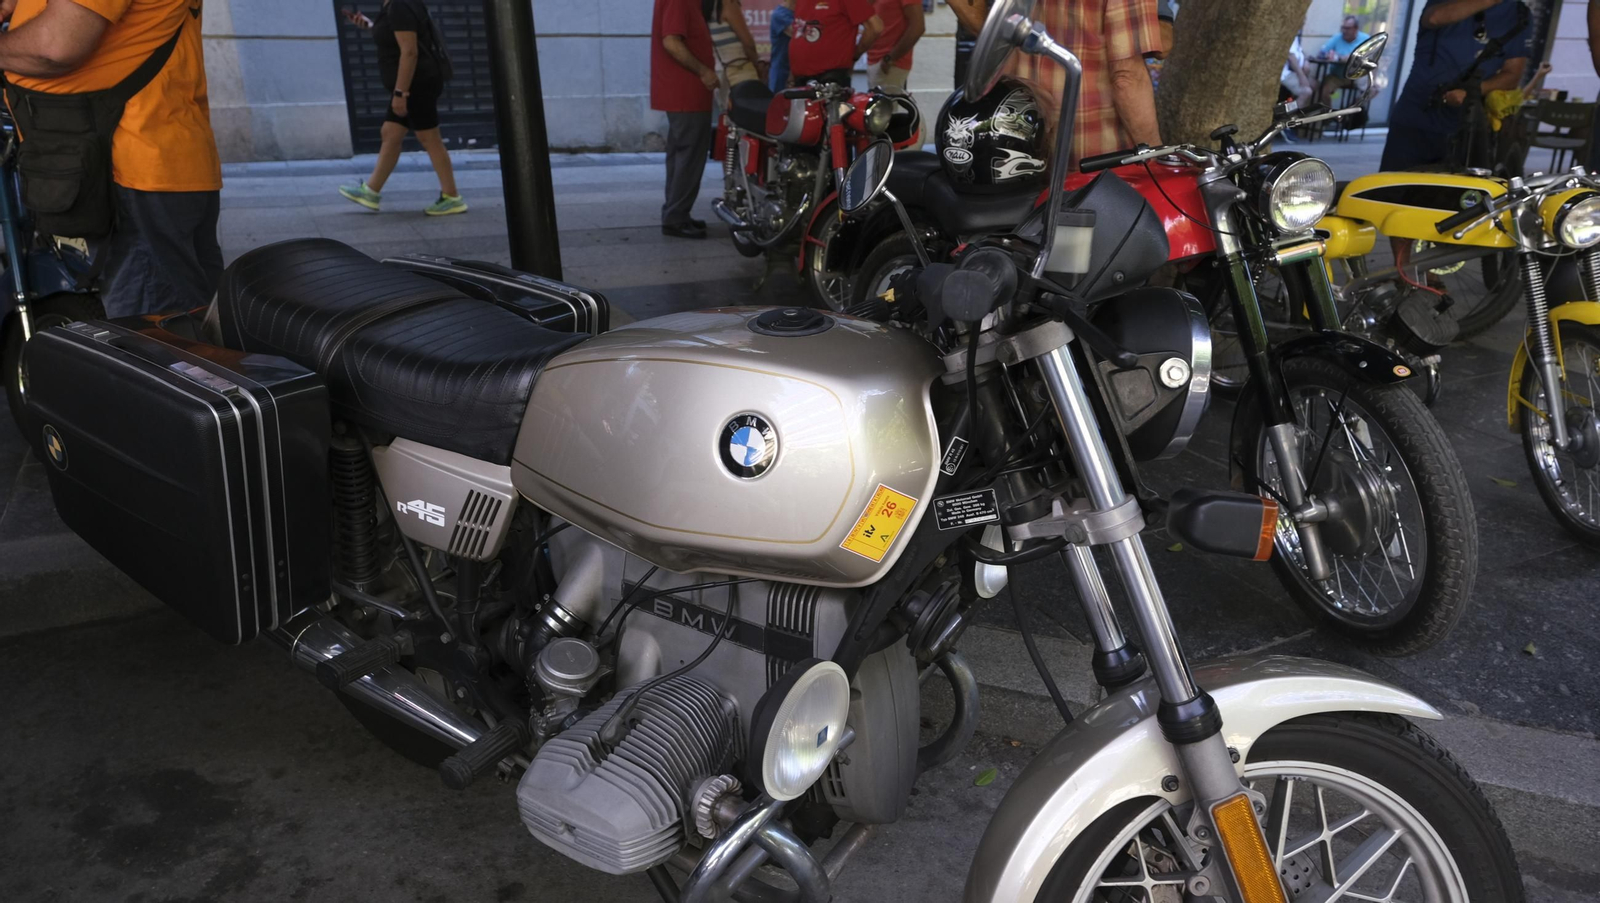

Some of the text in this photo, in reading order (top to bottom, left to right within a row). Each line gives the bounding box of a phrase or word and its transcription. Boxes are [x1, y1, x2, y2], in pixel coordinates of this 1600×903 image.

[728, 416, 773, 440] BMW
[882, 501, 897, 518] 26
[863, 525, 876, 538] itv
[653, 598, 739, 639] BMW
